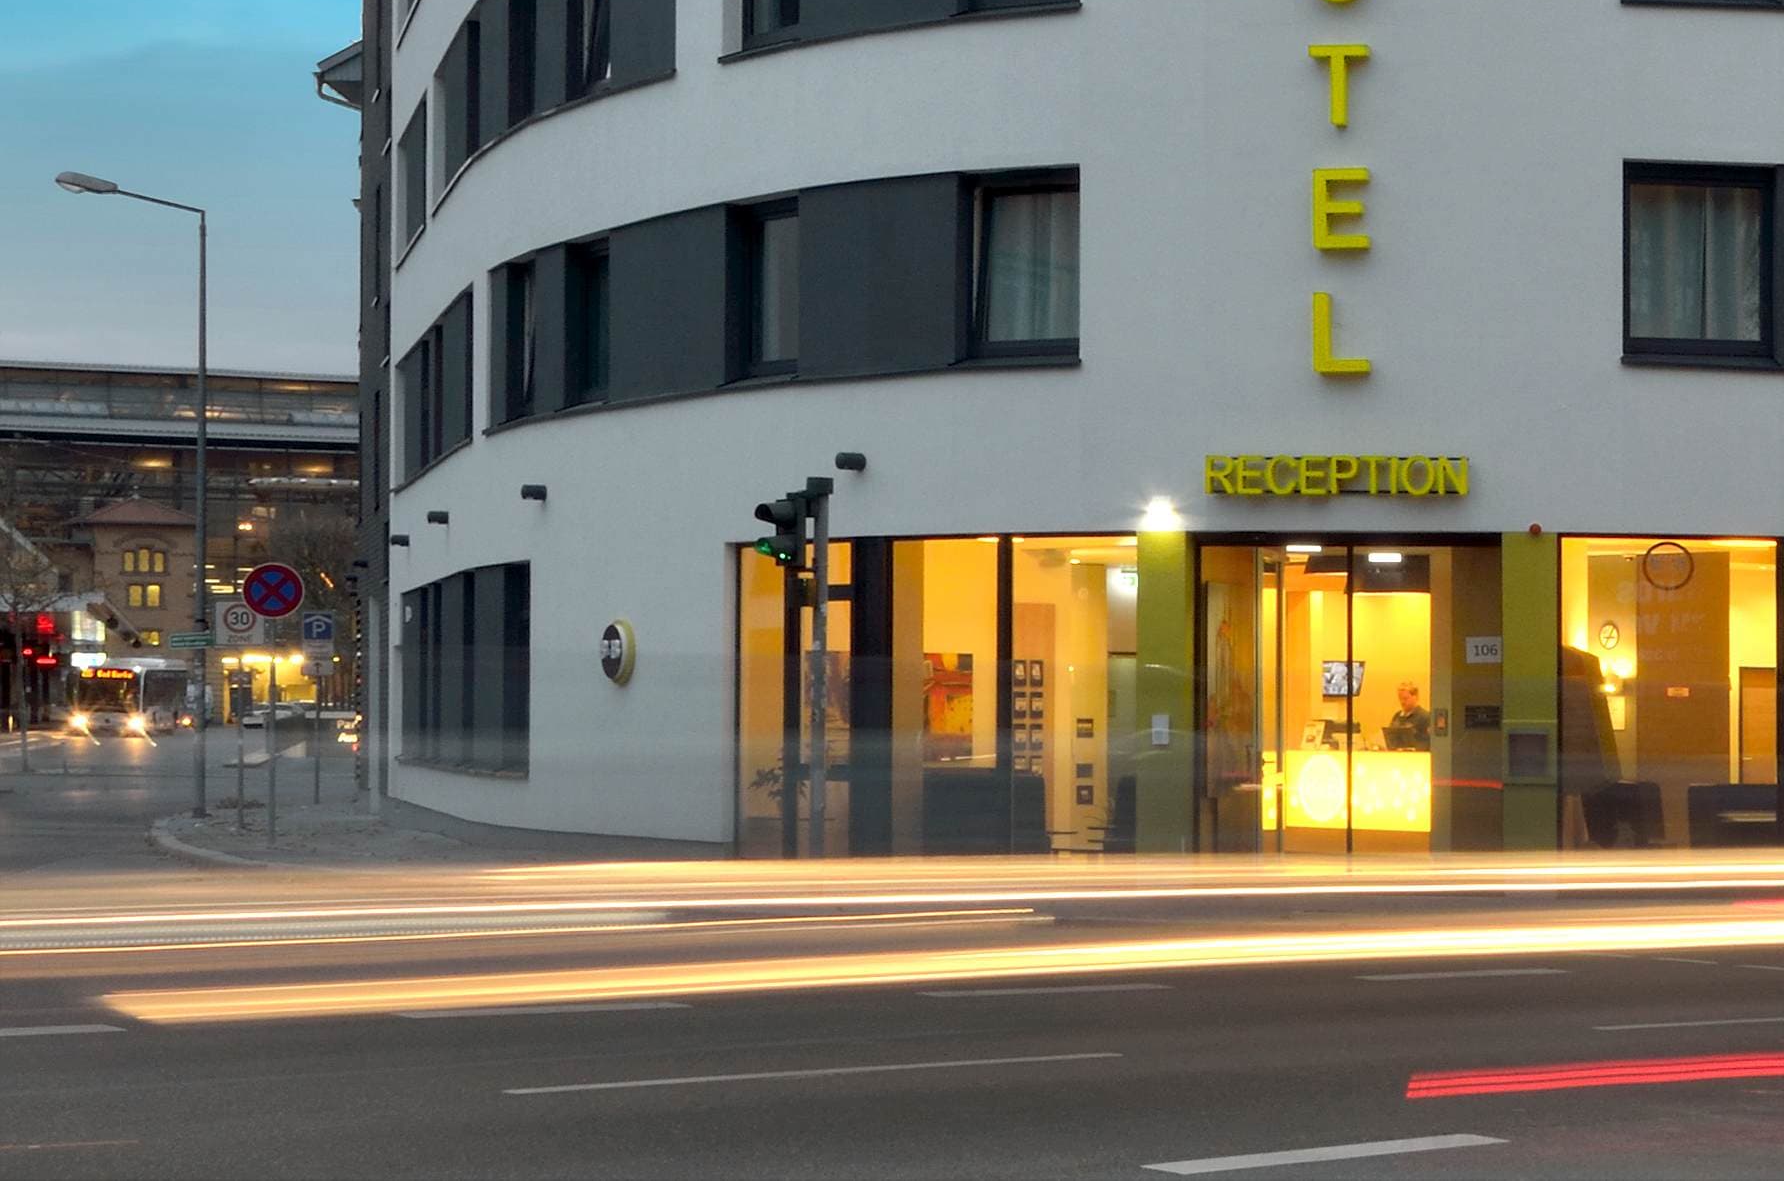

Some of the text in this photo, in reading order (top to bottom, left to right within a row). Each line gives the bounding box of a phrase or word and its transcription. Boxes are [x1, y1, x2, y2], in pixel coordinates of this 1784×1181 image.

[1204, 454, 1469, 497] RECEPTION
[230, 611, 249, 625] 30
[312, 621, 326, 638] P
[1474, 643, 1498, 657] 106
